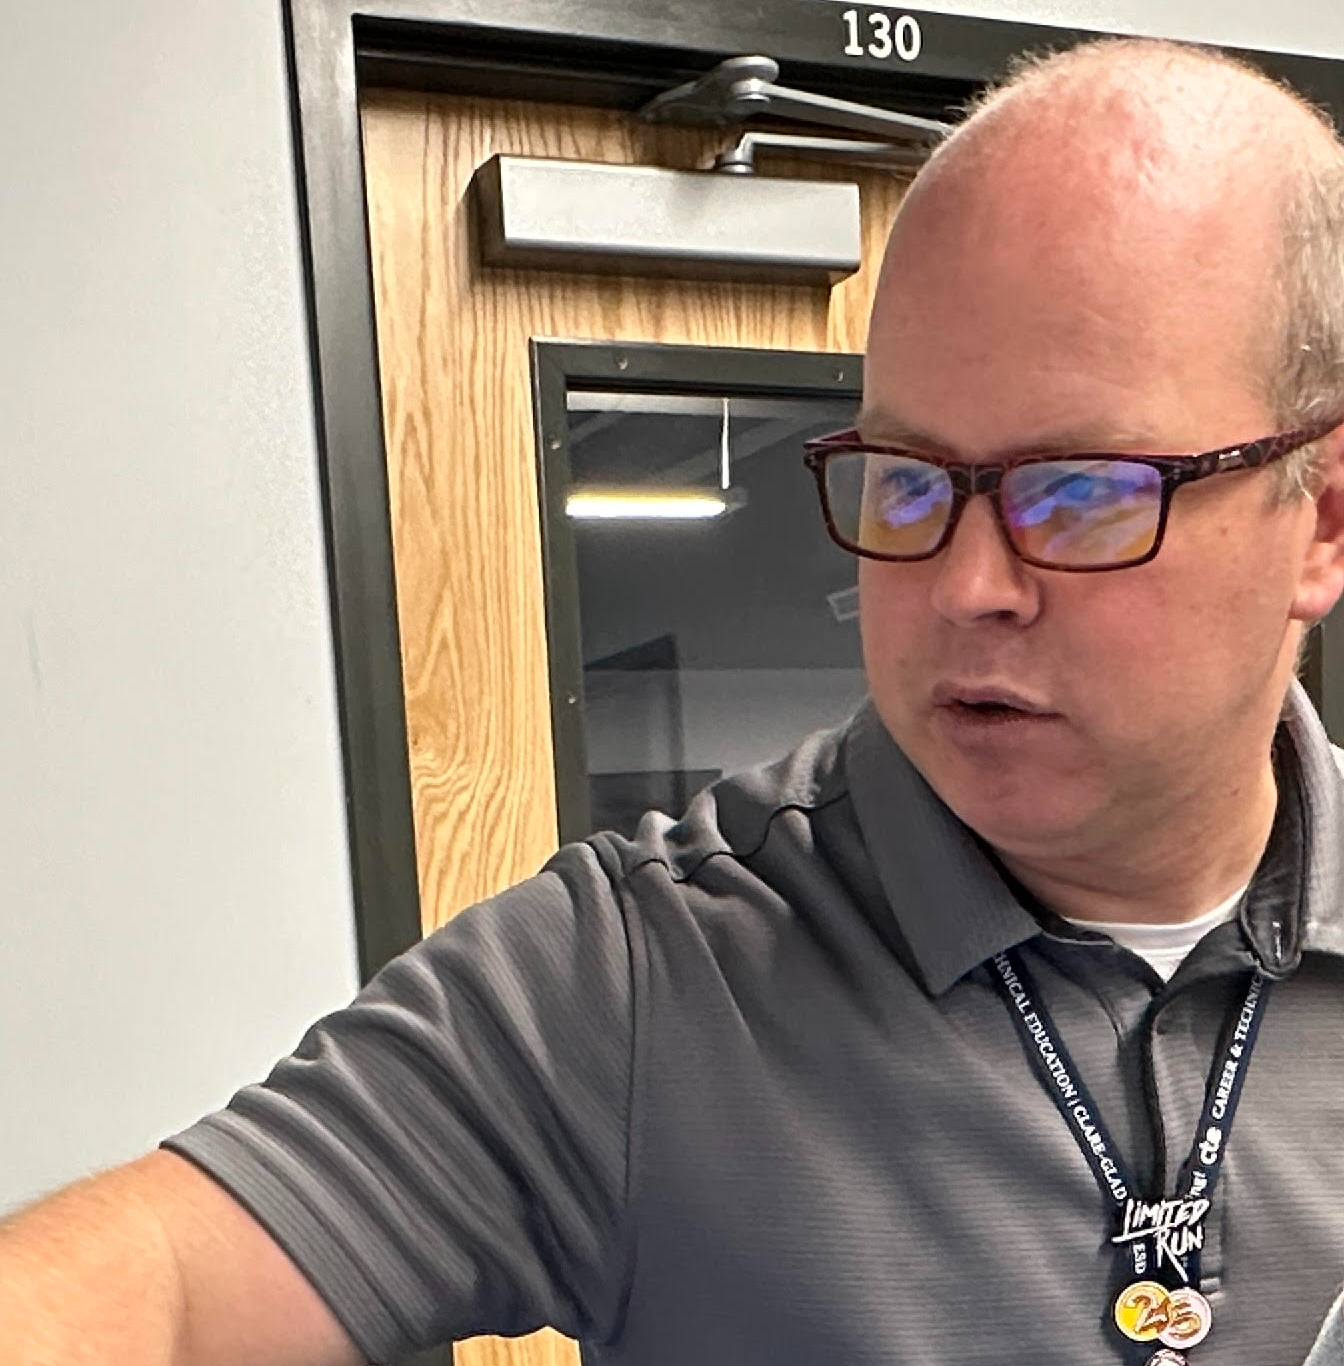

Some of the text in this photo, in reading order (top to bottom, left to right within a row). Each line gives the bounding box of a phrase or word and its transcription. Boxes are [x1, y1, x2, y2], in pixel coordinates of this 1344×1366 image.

[842, 8, 922, 62] 130
[995, 950, 1032, 1014] HNICAL
[1023, 1011, 1078, 1099] EDUCATION
[1072, 1104, 1128, 1204] CLARE-GLAD
[1211, 1059, 1239, 1120] CAREER
[1110, 1197, 1211, 1243] LIMITED
[1155, 1224, 1206, 1283] RUN
